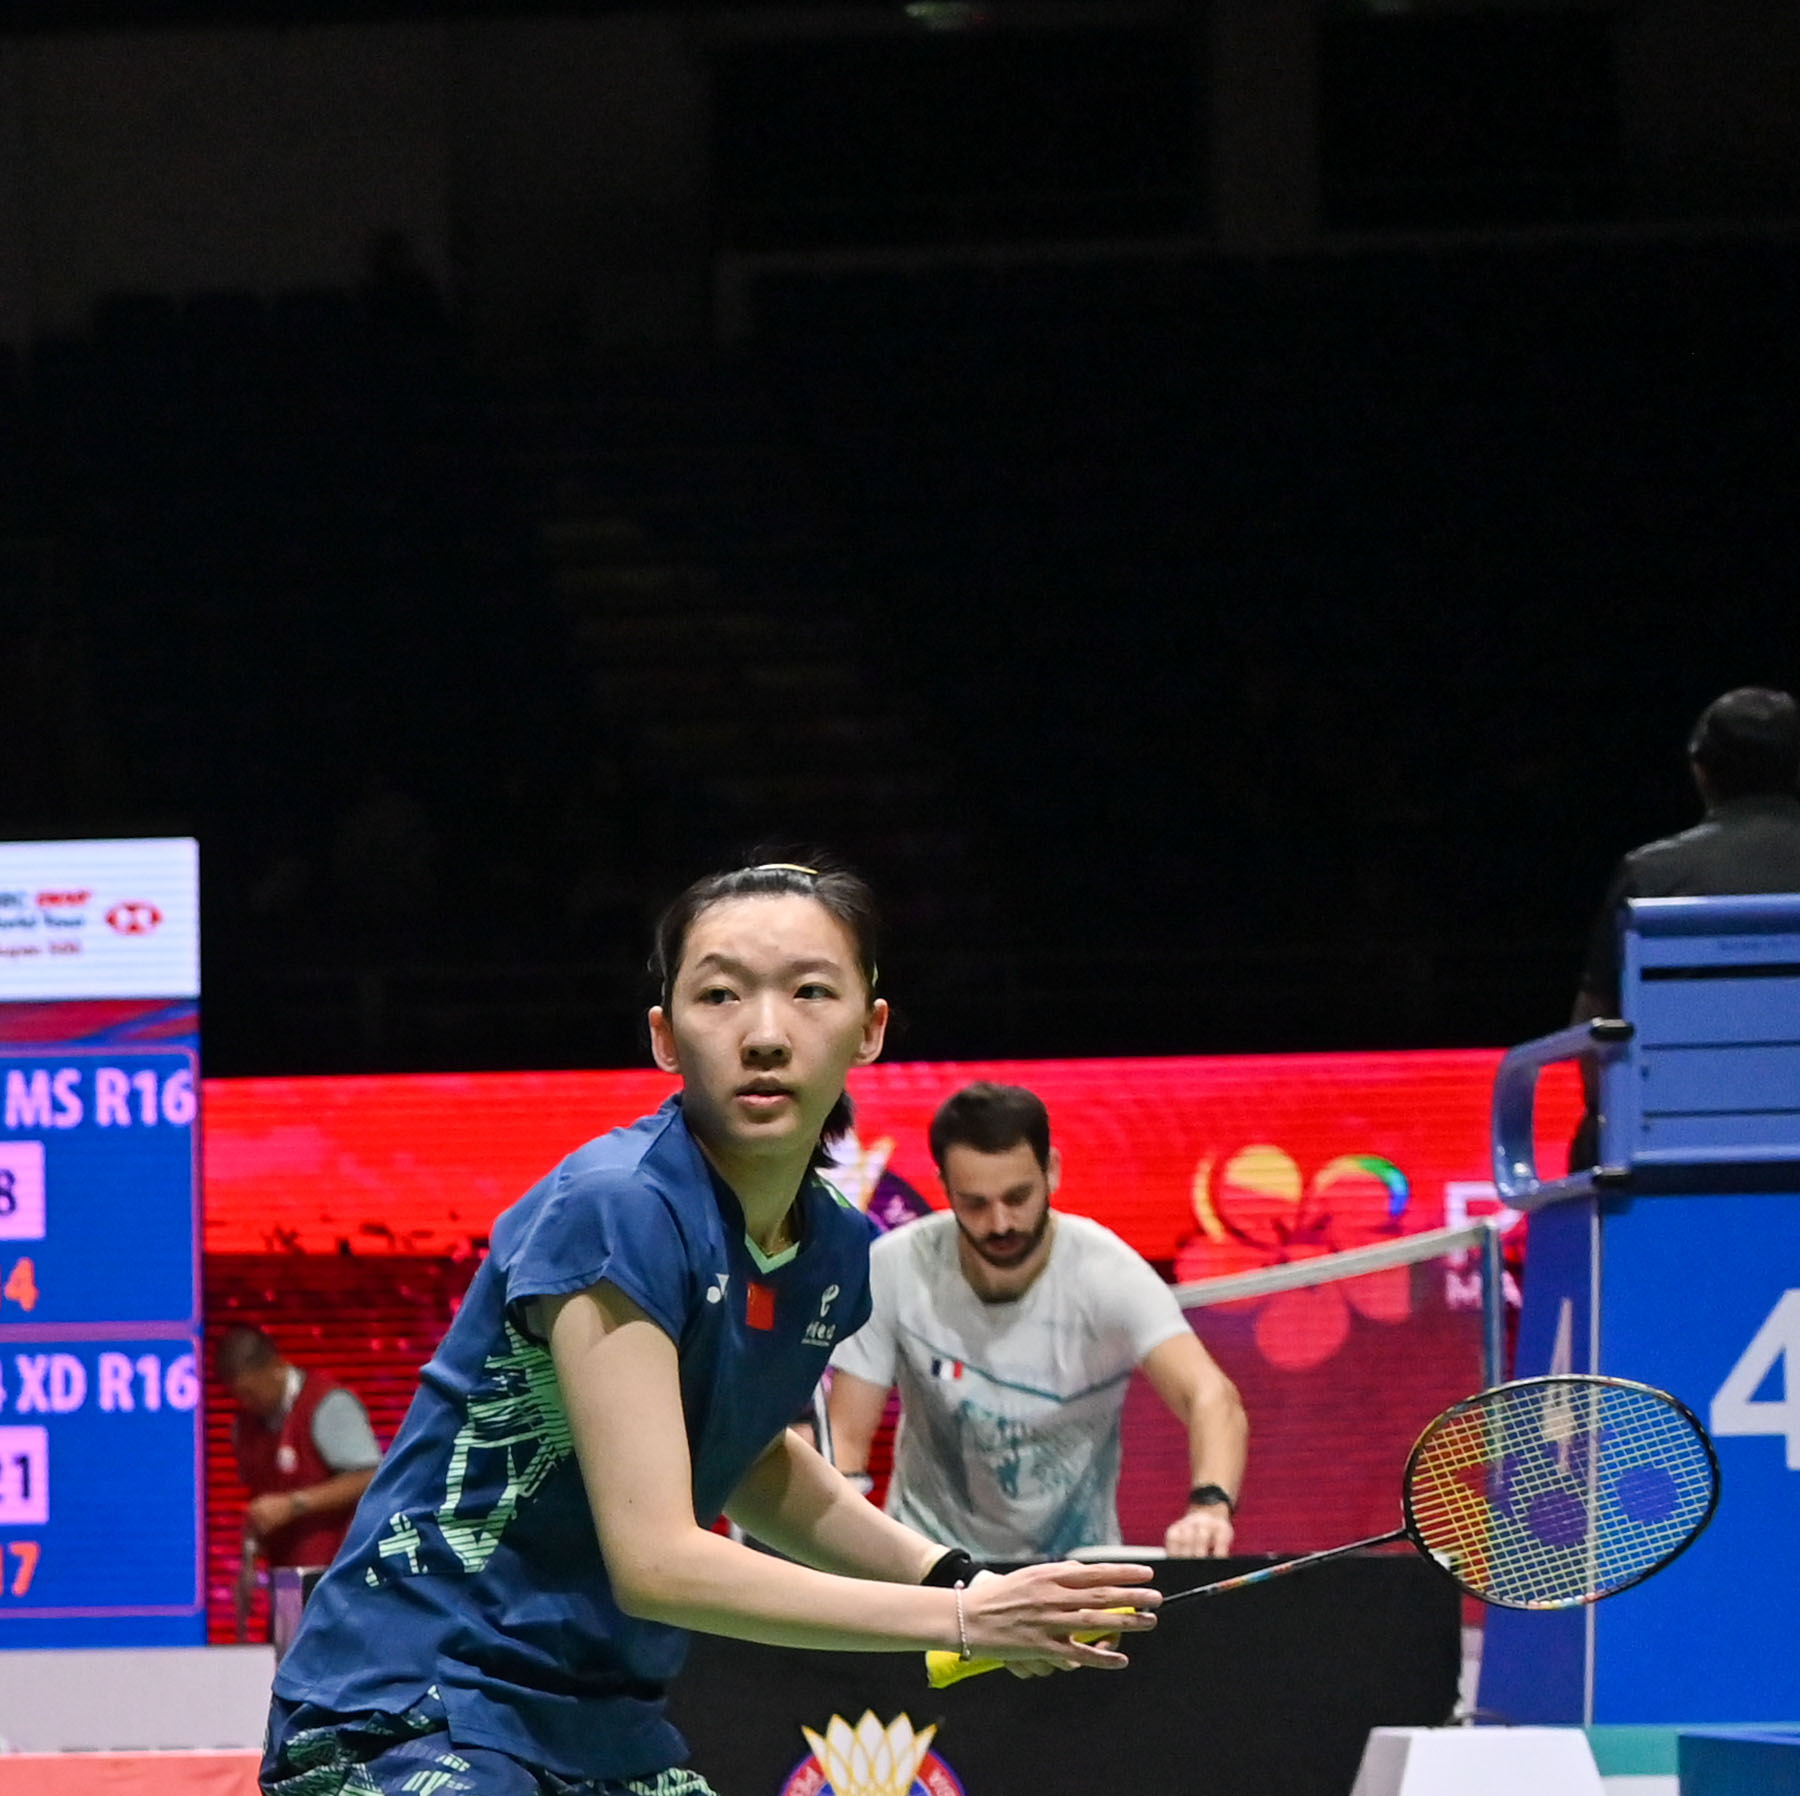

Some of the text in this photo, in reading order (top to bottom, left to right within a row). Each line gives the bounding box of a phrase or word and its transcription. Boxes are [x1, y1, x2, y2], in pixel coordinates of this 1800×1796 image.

[3, 1073, 82, 1130] MS
[94, 1067, 197, 1128] R16
[16, 1354, 87, 1414] XD
[98, 1352, 198, 1413] R16
